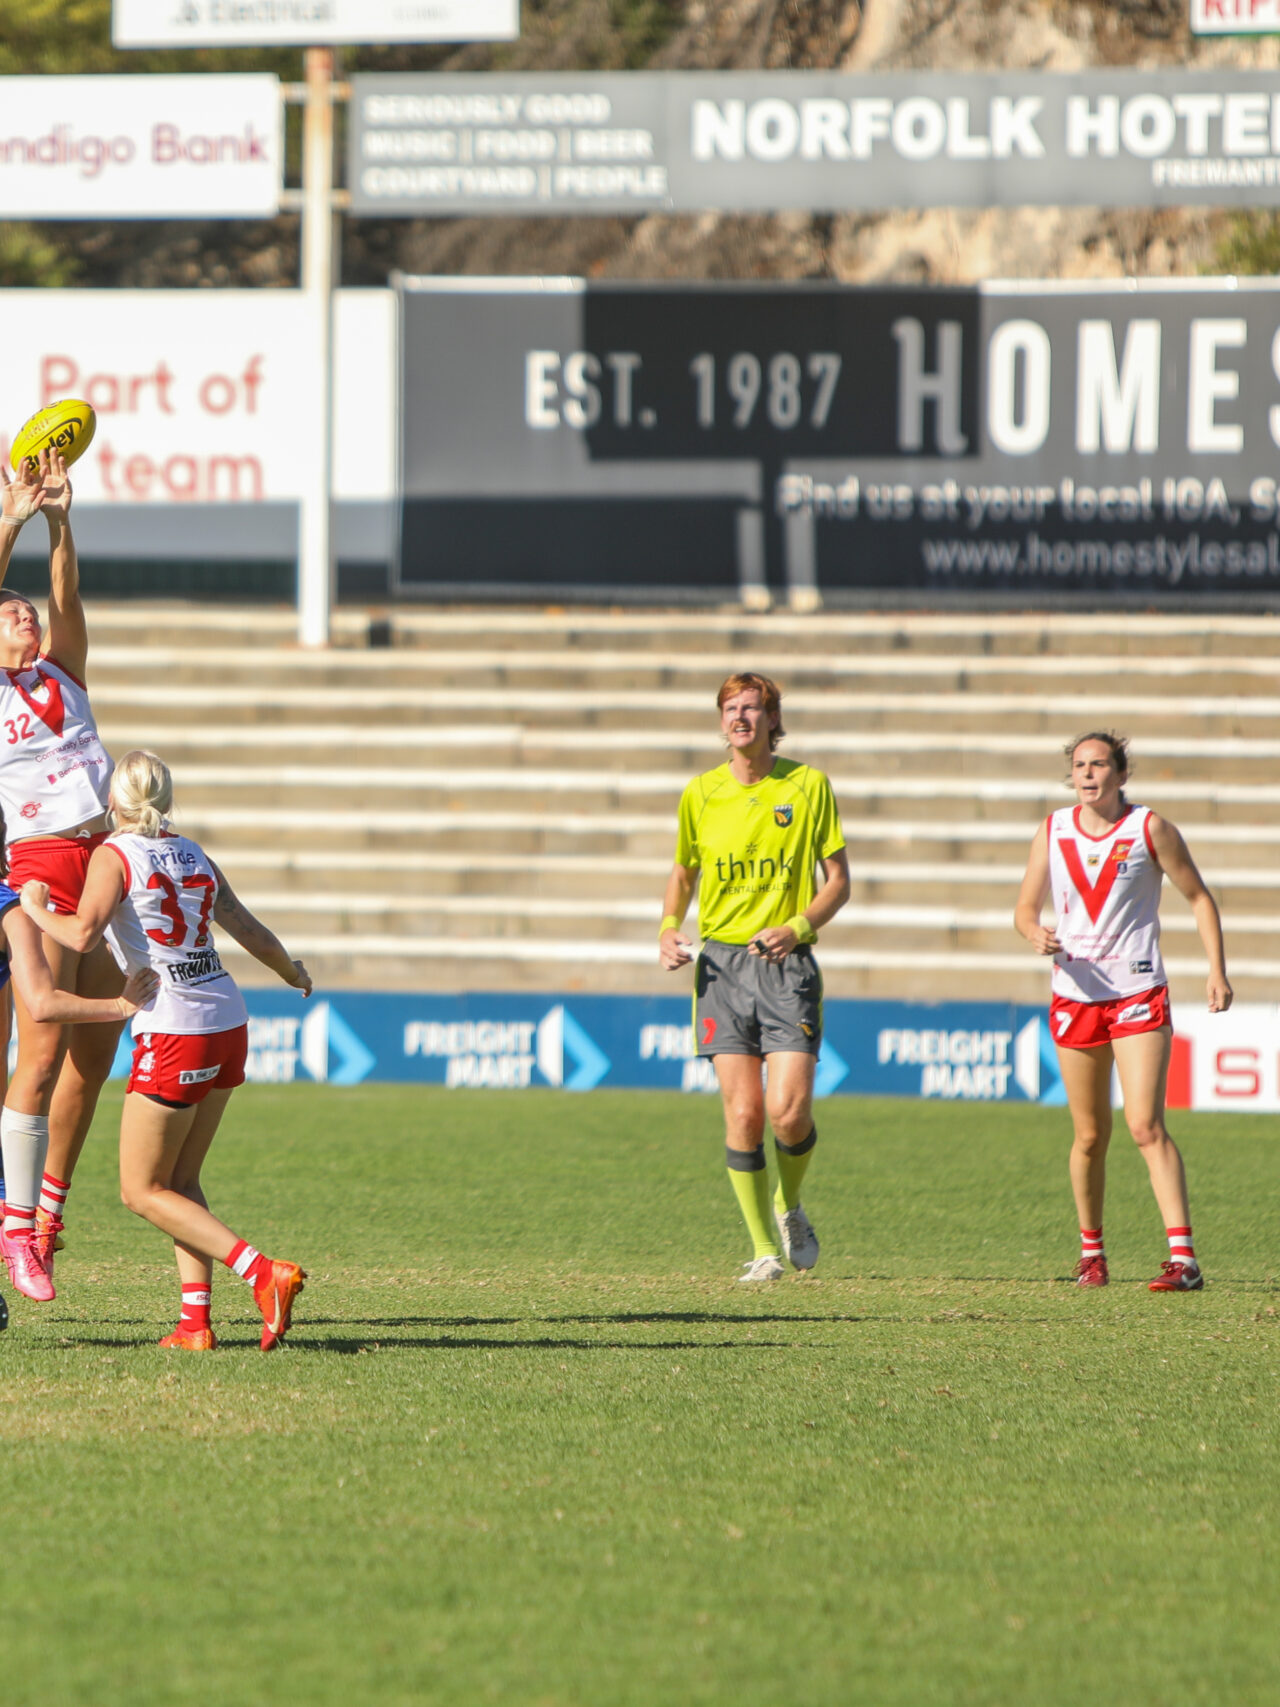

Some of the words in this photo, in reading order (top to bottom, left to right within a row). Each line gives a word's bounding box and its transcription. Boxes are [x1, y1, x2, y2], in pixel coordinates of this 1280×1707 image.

[363, 95, 521, 126] SERIOUSLY
[524, 93, 612, 125] GOOD
[151, 122, 268, 166] Bank
[362, 130, 458, 161] MUSIC
[474, 129, 558, 160] FOOD
[574, 129, 654, 161] BEER
[691, 97, 1046, 162] NORFOLK
[1067, 94, 1280, 158] HOTE
[361, 166, 537, 198] COURTYARD
[552, 165, 669, 197] PEOPLE
[1152, 159, 1280, 188] FREMANT
[40, 354, 174, 416] Part
[198, 352, 264, 416] of
[524, 350, 658, 430] EST.
[689, 351, 842, 430] 1987
[890, 315, 1280, 458] HOME
[96, 440, 265, 503] team
[867, 485, 914, 519] us
[922, 479, 960, 519] at
[966, 486, 1055, 527] your
[1062, 476, 1152, 520] local
[1163, 477, 1241, 524] IGA,
[4, 713, 36, 745] 32
[716, 849, 794, 882] think
[721, 885, 758, 896] MENTAL
[760, 883, 793, 893] HEALTH
[146, 872, 216, 948] 37
[404, 1021, 536, 1056] FREIGHT
[877, 1029, 1013, 1064] FREIGHT
[445, 1056, 537, 1088] MART
[921, 1064, 1012, 1098] MART
